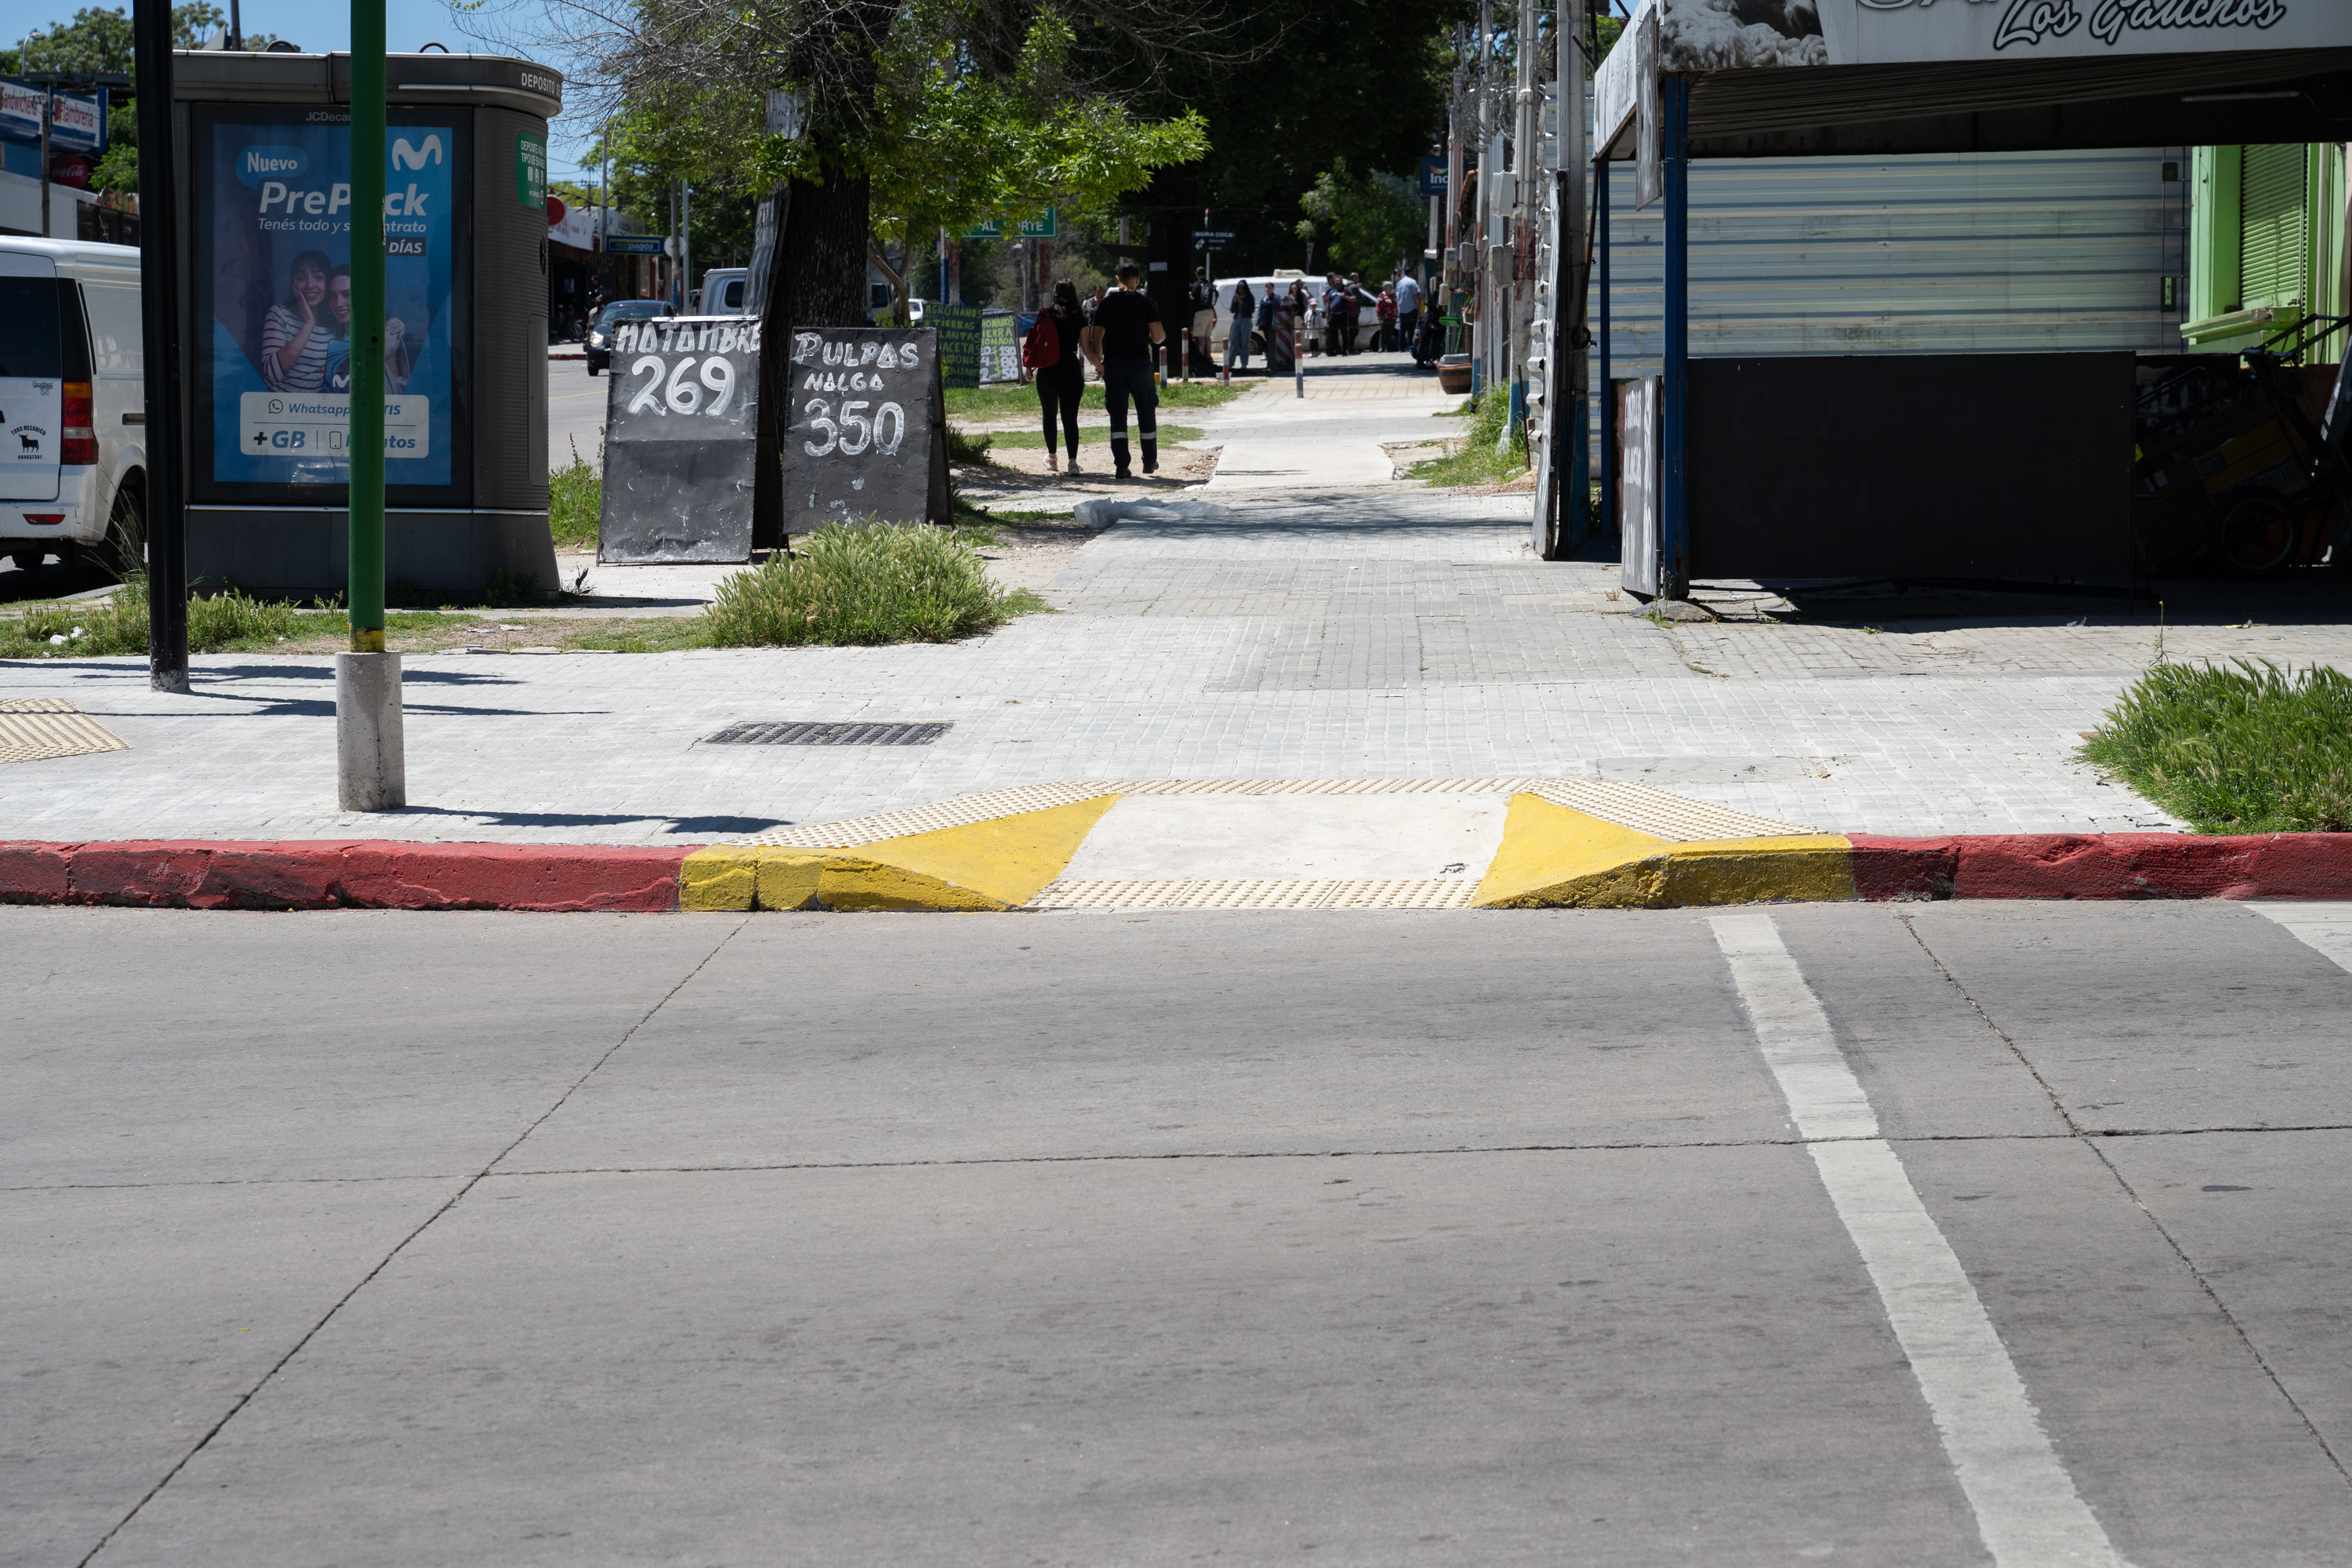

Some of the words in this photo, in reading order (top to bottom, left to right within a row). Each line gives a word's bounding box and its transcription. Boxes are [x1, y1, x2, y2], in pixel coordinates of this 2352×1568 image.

[1994, 0, 2081, 49] Los
[2090, 0, 2285, 45] Gauchos
[521, 72, 556, 94] DEPÓSITO
[247, 151, 298, 172] Nuevo
[259, 181, 430, 216] PrePck
[258, 218, 296, 230] Tenés
[299, 219, 329, 230] todo
[331, 222, 340, 234] y
[385, 221, 426, 233] ntrato
[982, 221, 996, 231] AL
[388, 239, 422, 254] DÍAS
[933, 318, 975, 330] TIERRAS
[982, 327, 1013, 338] IERRA
[615, 321, 761, 354] MATAMBRE
[981, 337, 1014, 346] BONADA
[791, 332, 920, 369] PULPAS
[939, 342, 980, 355] ACETAS
[628, 355, 736, 416] 269
[804, 372, 884, 391] NALGA
[289, 403, 350, 417] Whatsapp
[385, 405, 401, 416] TIS
[10, 426, 23, 436] TORO
[24, 425, 46, 436] MECANICO
[804, 398, 905, 457] 350
